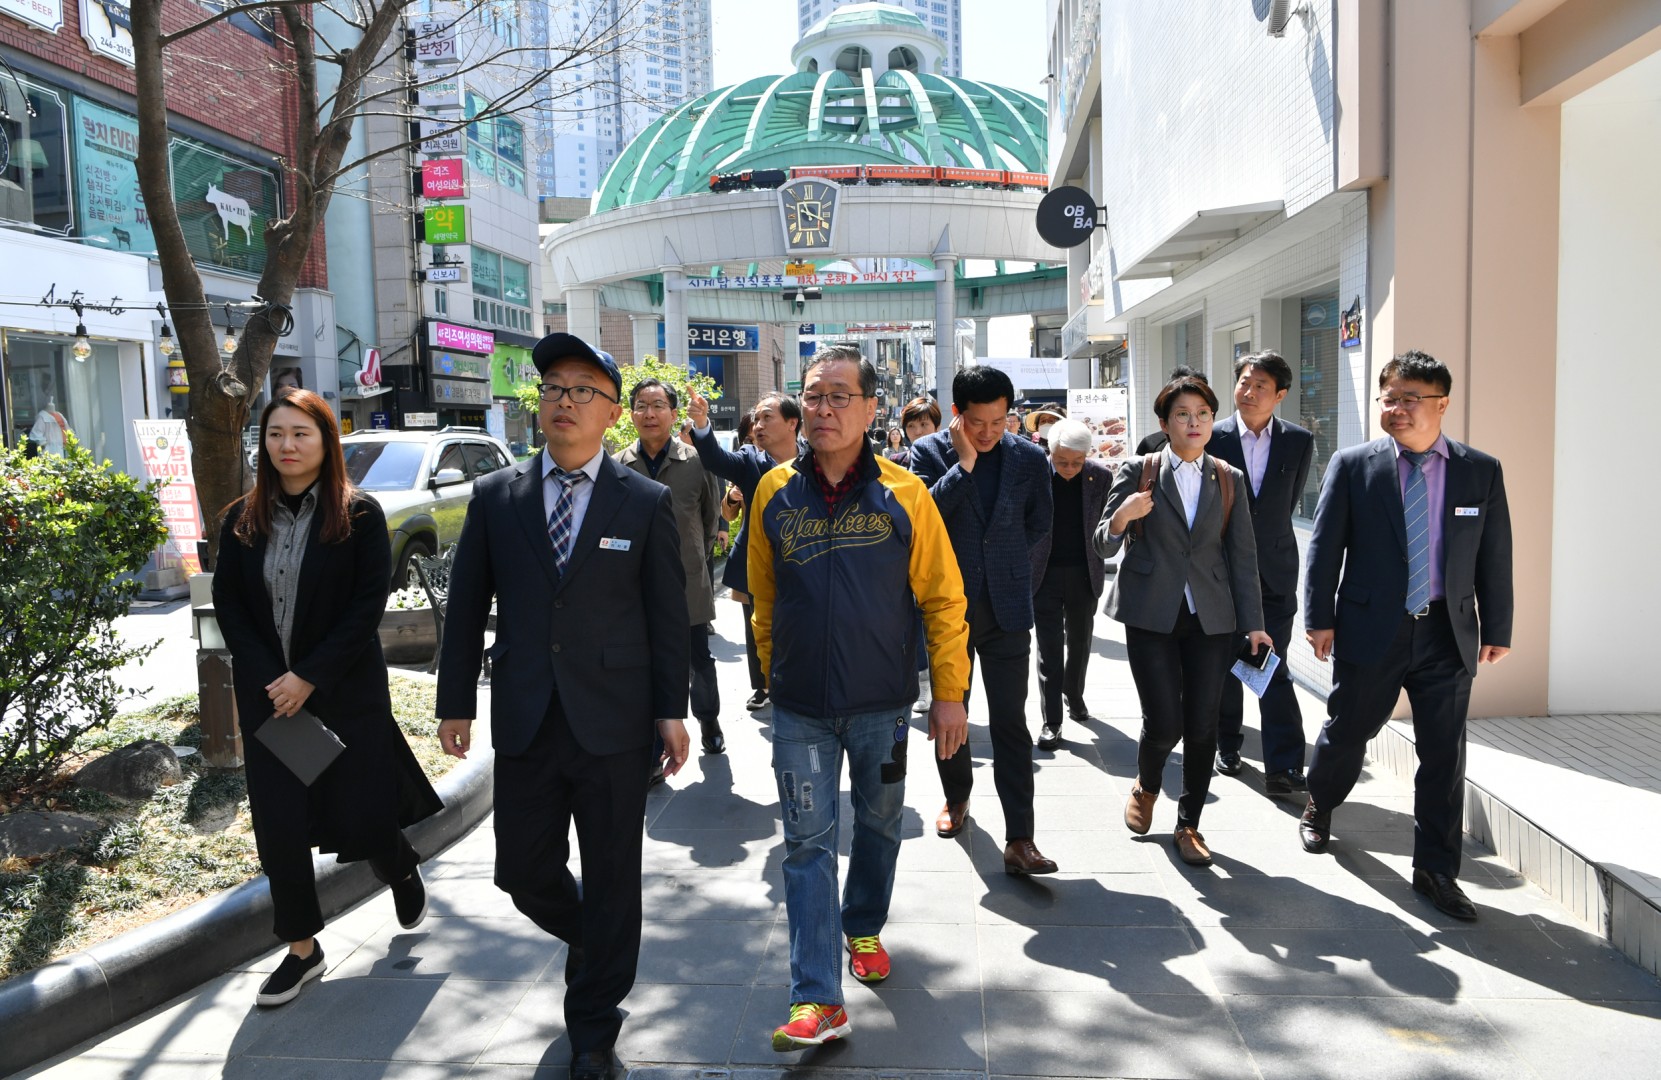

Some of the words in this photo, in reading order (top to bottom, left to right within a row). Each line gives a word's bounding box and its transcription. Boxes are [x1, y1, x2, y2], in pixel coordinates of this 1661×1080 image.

[31, 2, 53, 17] BEER
[101, 37, 132, 57] 246-3315
[418, 40, 454, 56] 보청기
[426, 179, 460, 191] 여성의원
[1063, 205, 1085, 217] OB
[434, 208, 454, 232] 약
[1073, 217, 1093, 229] BA
[434, 232, 459, 241] 세명약국
[432, 270, 457, 280] 신보사
[824, 272, 847, 286] 운행
[863, 272, 888, 282] 매시
[892, 270, 917, 284] 정각
[444, 327, 482, 349] 리즈여성의원
[688, 328, 746, 347] 우리은행
[776, 503, 892, 556] Yankees
